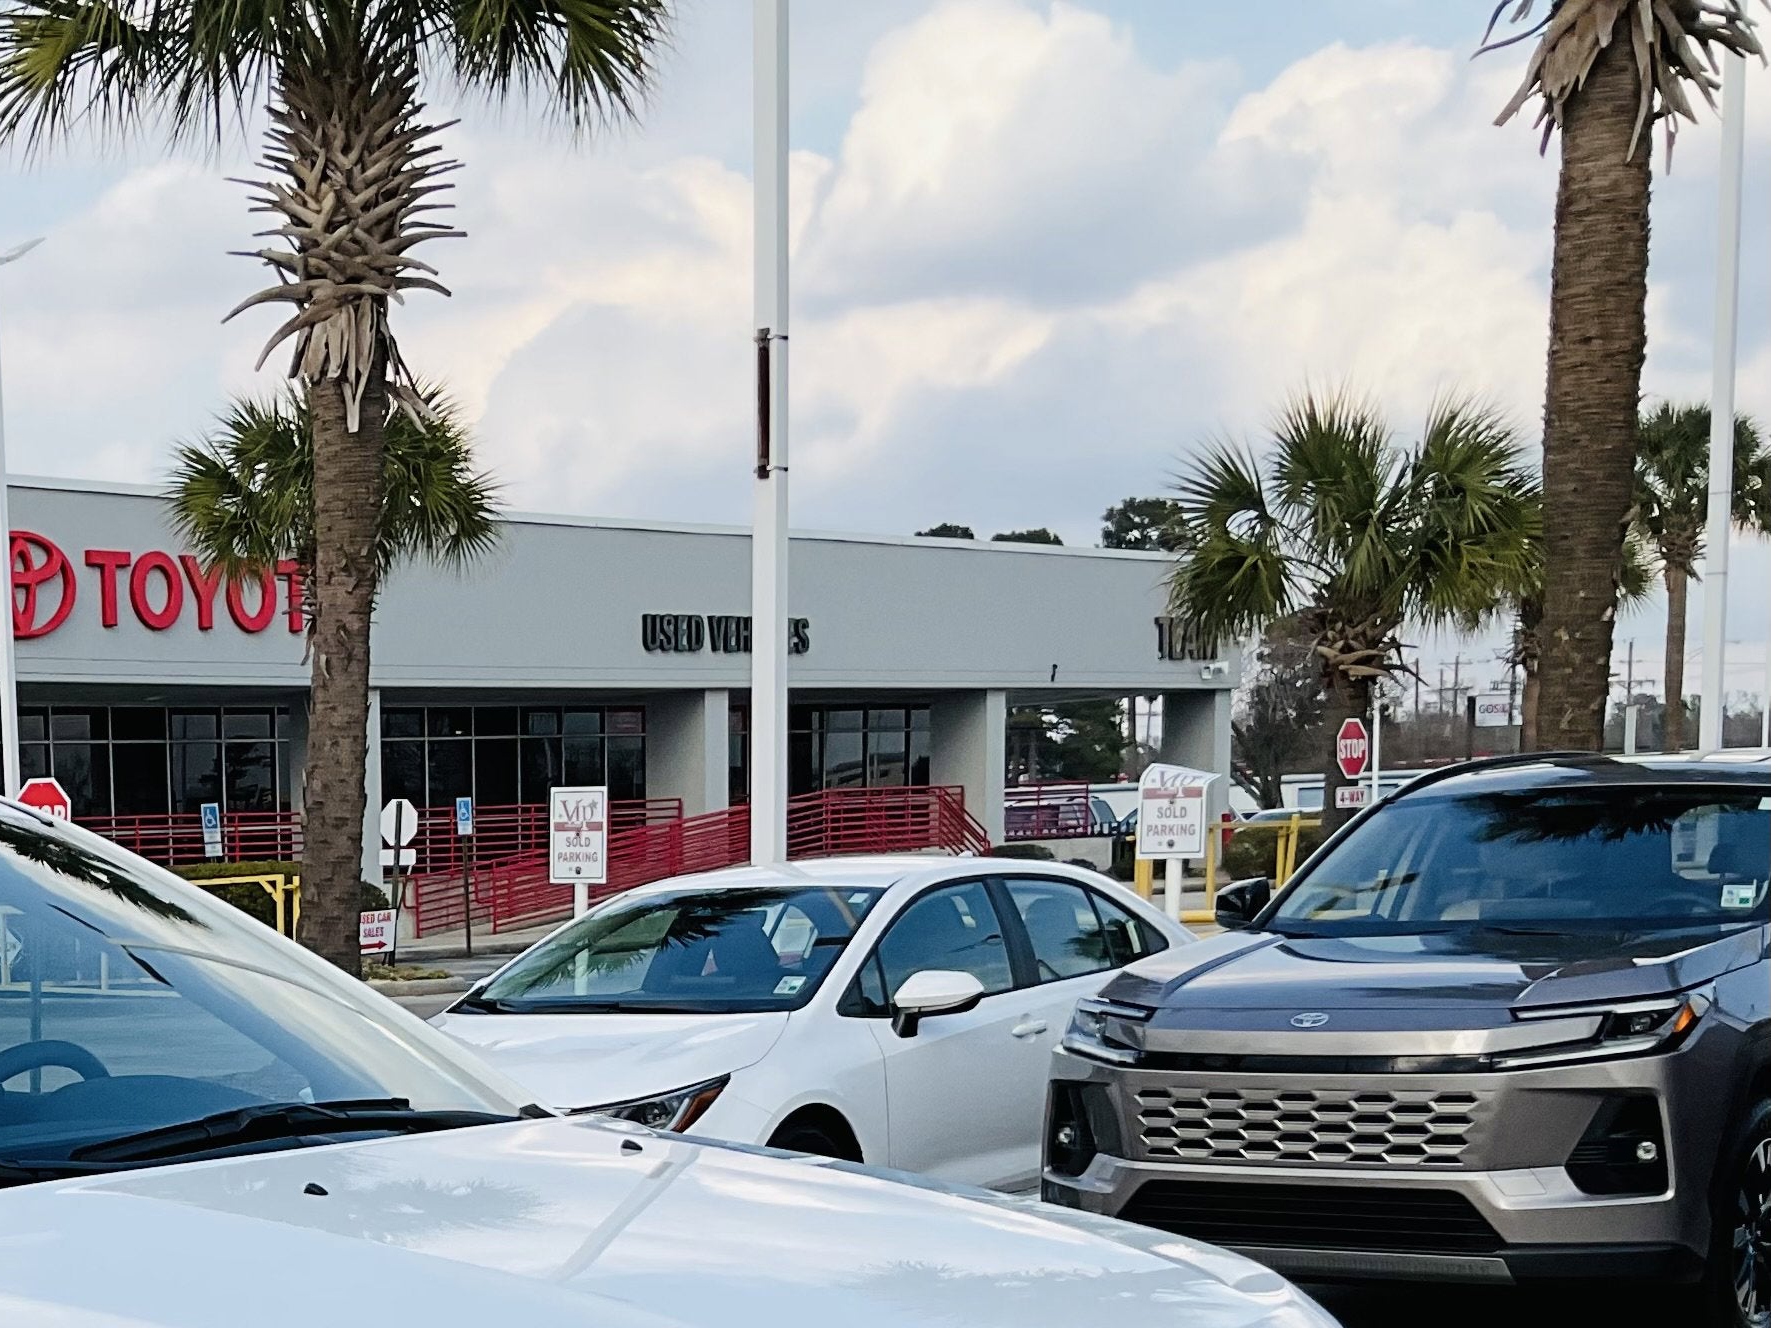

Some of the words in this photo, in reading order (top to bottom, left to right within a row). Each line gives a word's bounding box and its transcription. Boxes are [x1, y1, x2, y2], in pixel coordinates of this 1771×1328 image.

[85, 550, 304, 632] TOYOT
[642, 614, 705, 652] USED
[707, 615, 809, 654] VEHES
[1339, 738, 1365, 759] STOP
[1339, 791, 1365, 803] 4-WAY
[1156, 806, 1187, 819] SOLD
[1146, 823, 1196, 837] PARKING
[565, 836, 591, 847] SOLD
[557, 851, 599, 862] PARKING
[360, 913, 375, 924] SED
[377, 911, 392, 923] CAR
[363, 926, 384, 938] SALES
